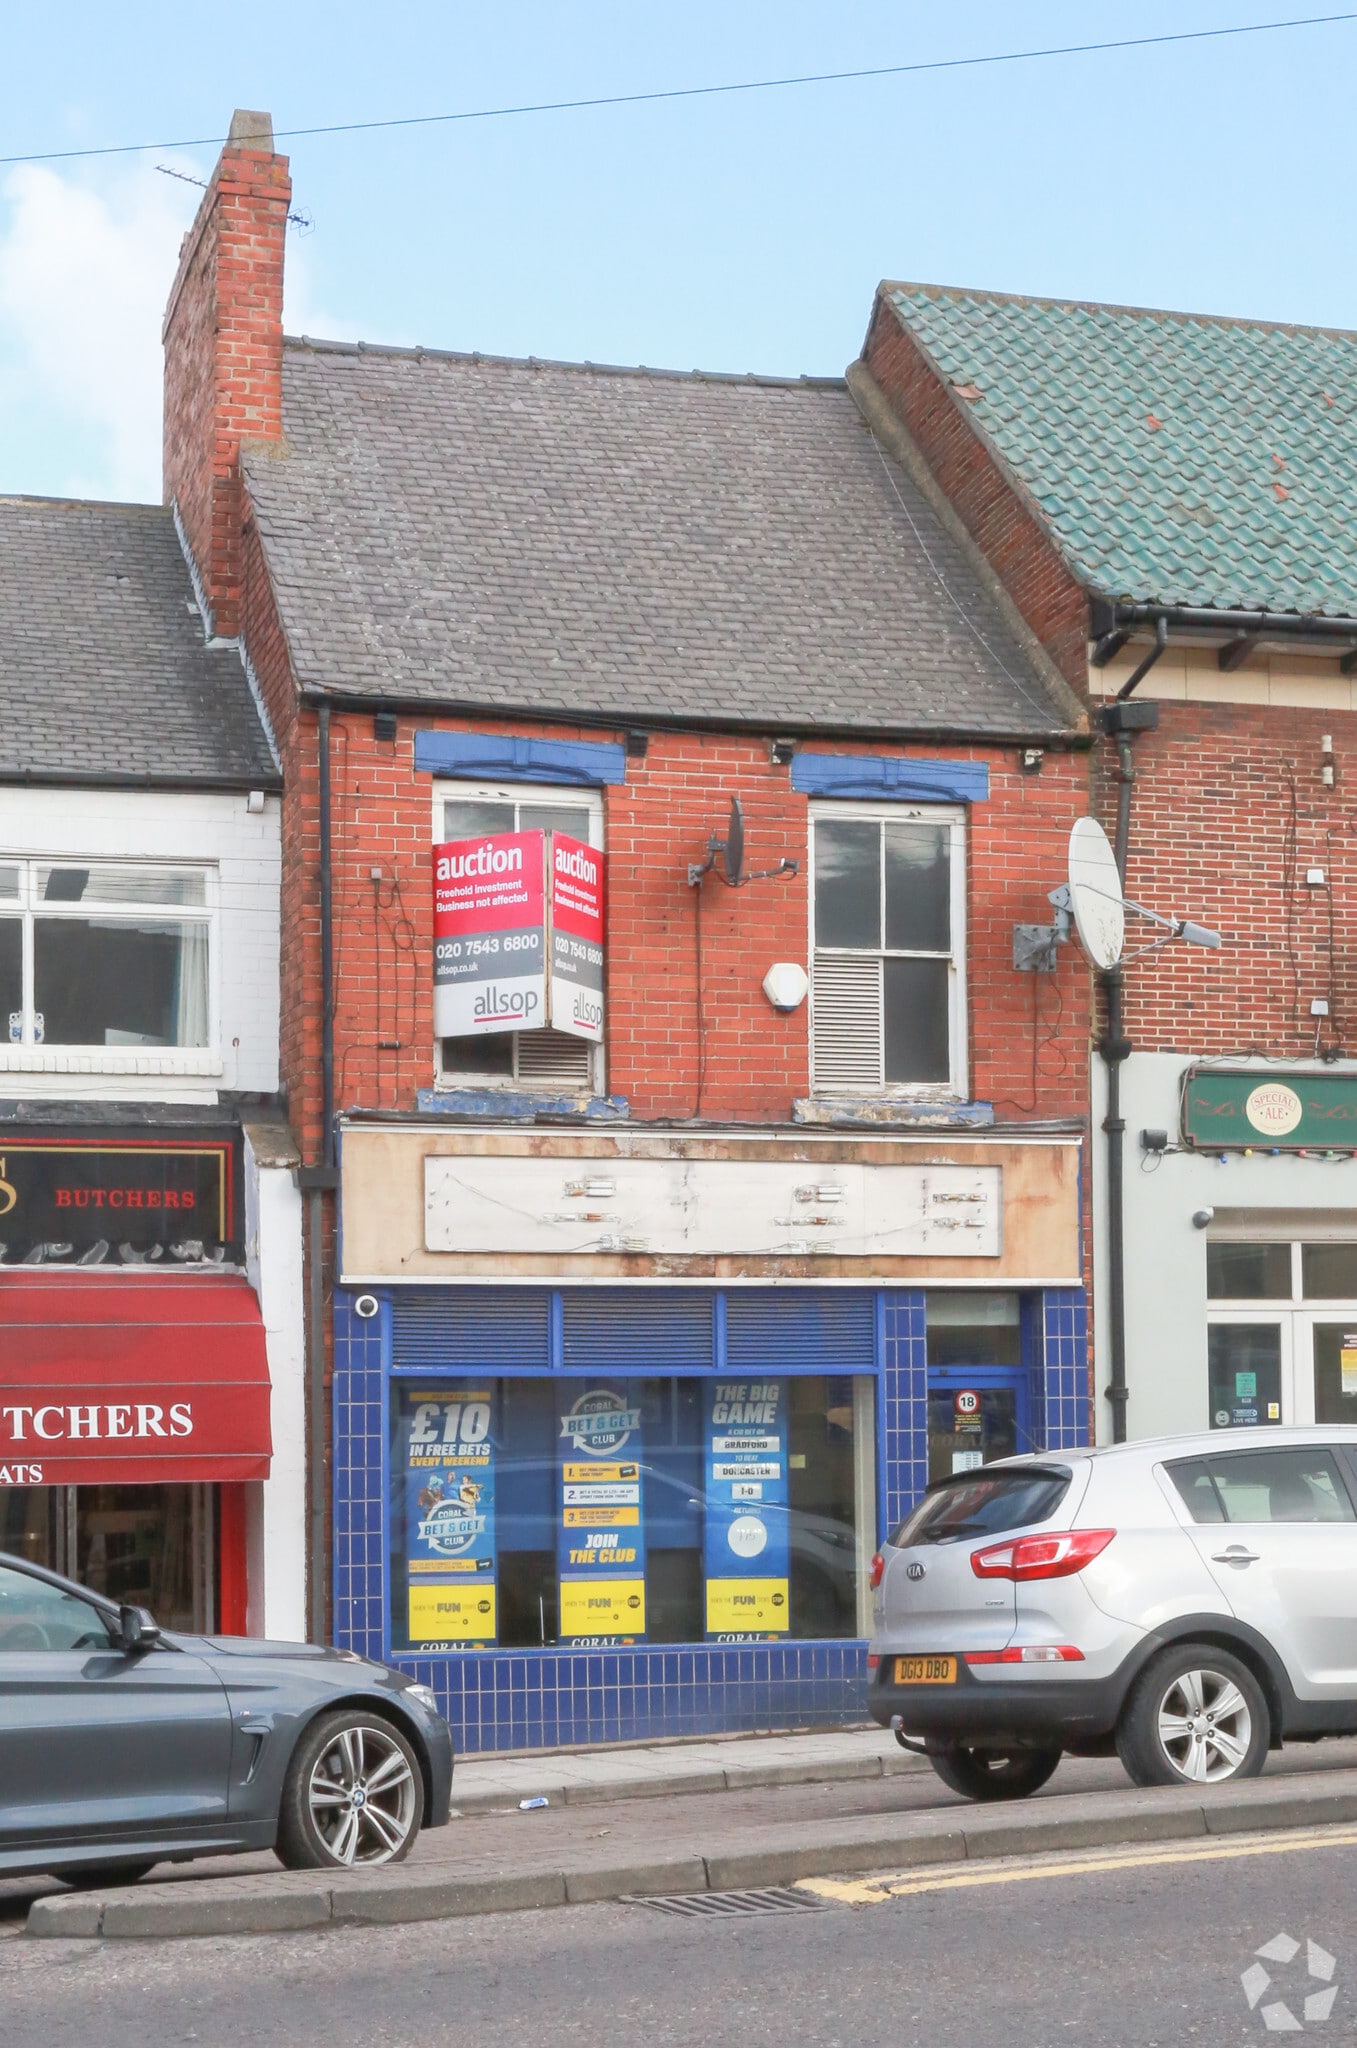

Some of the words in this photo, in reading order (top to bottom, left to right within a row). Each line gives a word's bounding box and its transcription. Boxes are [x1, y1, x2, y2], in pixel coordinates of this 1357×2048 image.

[436, 843, 522, 881] auction
[555, 848, 597, 886] auction
[436, 885, 473, 898] Freehold
[475, 879, 522, 894] investment
[436, 901, 474, 912] Business
[476, 897, 490, 907] not
[492, 892, 528, 906] affected
[436, 943, 461, 959] 020
[465, 938, 499, 956] 7543
[503, 934, 539, 951] 6800
[555, 936, 569, 954] 020
[570, 941, 586, 960] 7543
[587, 948, 603, 966] 6800
[437, 962, 479, 976] allsop.co.uk
[474, 986, 538, 1017] allsop
[573, 992, 602, 1030] allsop
[1254, 1094, 1293, 1107] SPECIAL
[1266, 1107, 1283, 1119] ALE
[56, 1189, 195, 1208] BUTCHERS
[716, 1385, 747, 1401] THE
[750, 1385, 779, 1401] BIG
[960, 1396, 974, 1408] 18
[712, 1402, 777, 1424] GAME
[3, 1403, 193, 1440] TCHERS
[409, 1403, 490, 1443] £10
[568, 1418, 593, 1432] BET
[609, 1414, 633, 1428] GET
[592, 1434, 615, 1444] CLUB
[725, 1441, 768, 1449] BRADFORD
[409, 1444, 423, 1456] IN
[426, 1444, 456, 1456] FREE
[458, 1443, 490, 1456] BETS
[409, 1456, 440, 1467] EVERY
[443, 1456, 489, 1467] WEEKEND
[568, 1468, 575, 1477] 1.
[568, 1490, 576, 1499] 2.
[438, 1509, 462, 1519] CORAL
[568, 1512, 576, 1522] 3.
[424, 1523, 445, 1536] BET
[459, 1520, 480, 1532] GET
[444, 1536, 464, 1545] CLUB
[585, 1534, 619, 1548] JOIN
[569, 1549, 596, 1564] THE
[598, 1548, 636, 1563] CLUB
[908, 1565, 921, 1577] KIA
[588, 1598, 611, 1608] FUN
[733, 1595, 756, 1605] FUN
[437, 1602, 461, 1613] FUN
[571, 1638, 618, 1647] CORAL
[901, 1660, 923, 1679] DG13
[926, 1660, 949, 1679] DBO
